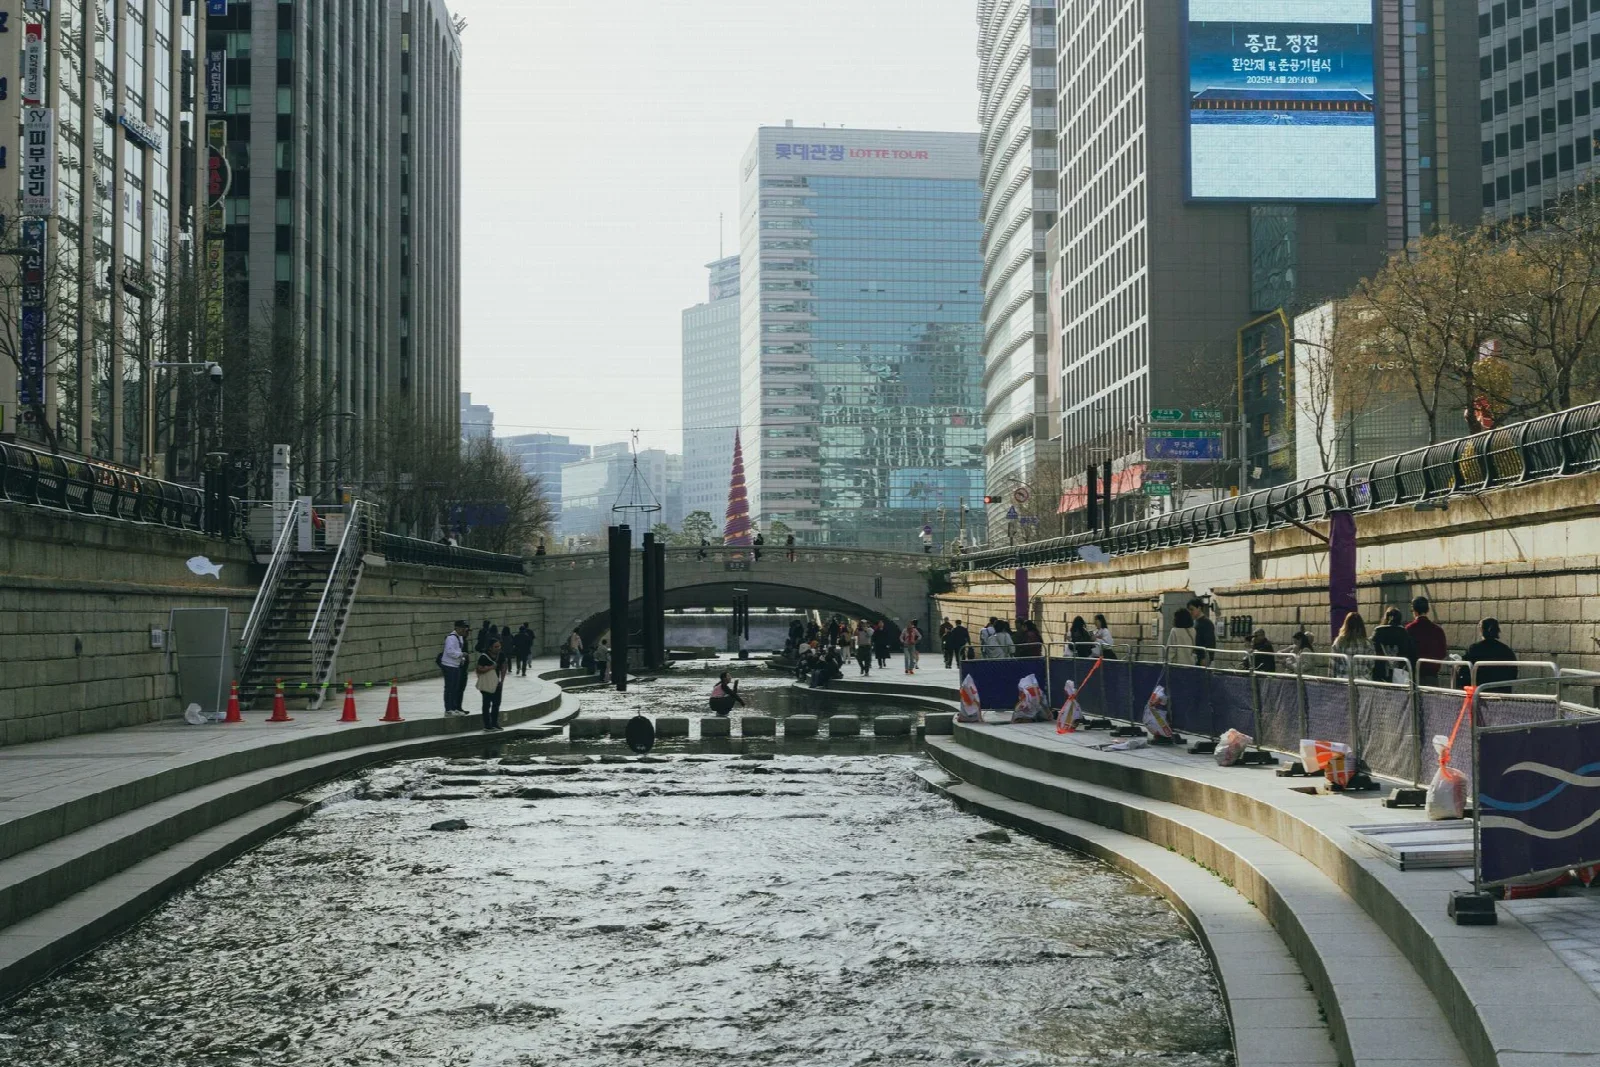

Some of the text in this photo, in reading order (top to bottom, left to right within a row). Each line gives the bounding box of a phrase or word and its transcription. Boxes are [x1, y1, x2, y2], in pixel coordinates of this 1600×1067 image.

[1244, 34, 1319, 54] 종묘 정전
[1232, 58, 1331, 72] 환안제 및 준공기념식
[1246, 75, 1273, 84] 2025년
[1274, 76, 1286, 84] 4월
[775, 143, 929, 161] 롯데관광 LOTTE TOUR
[28, 130, 46, 197] 피부관리
